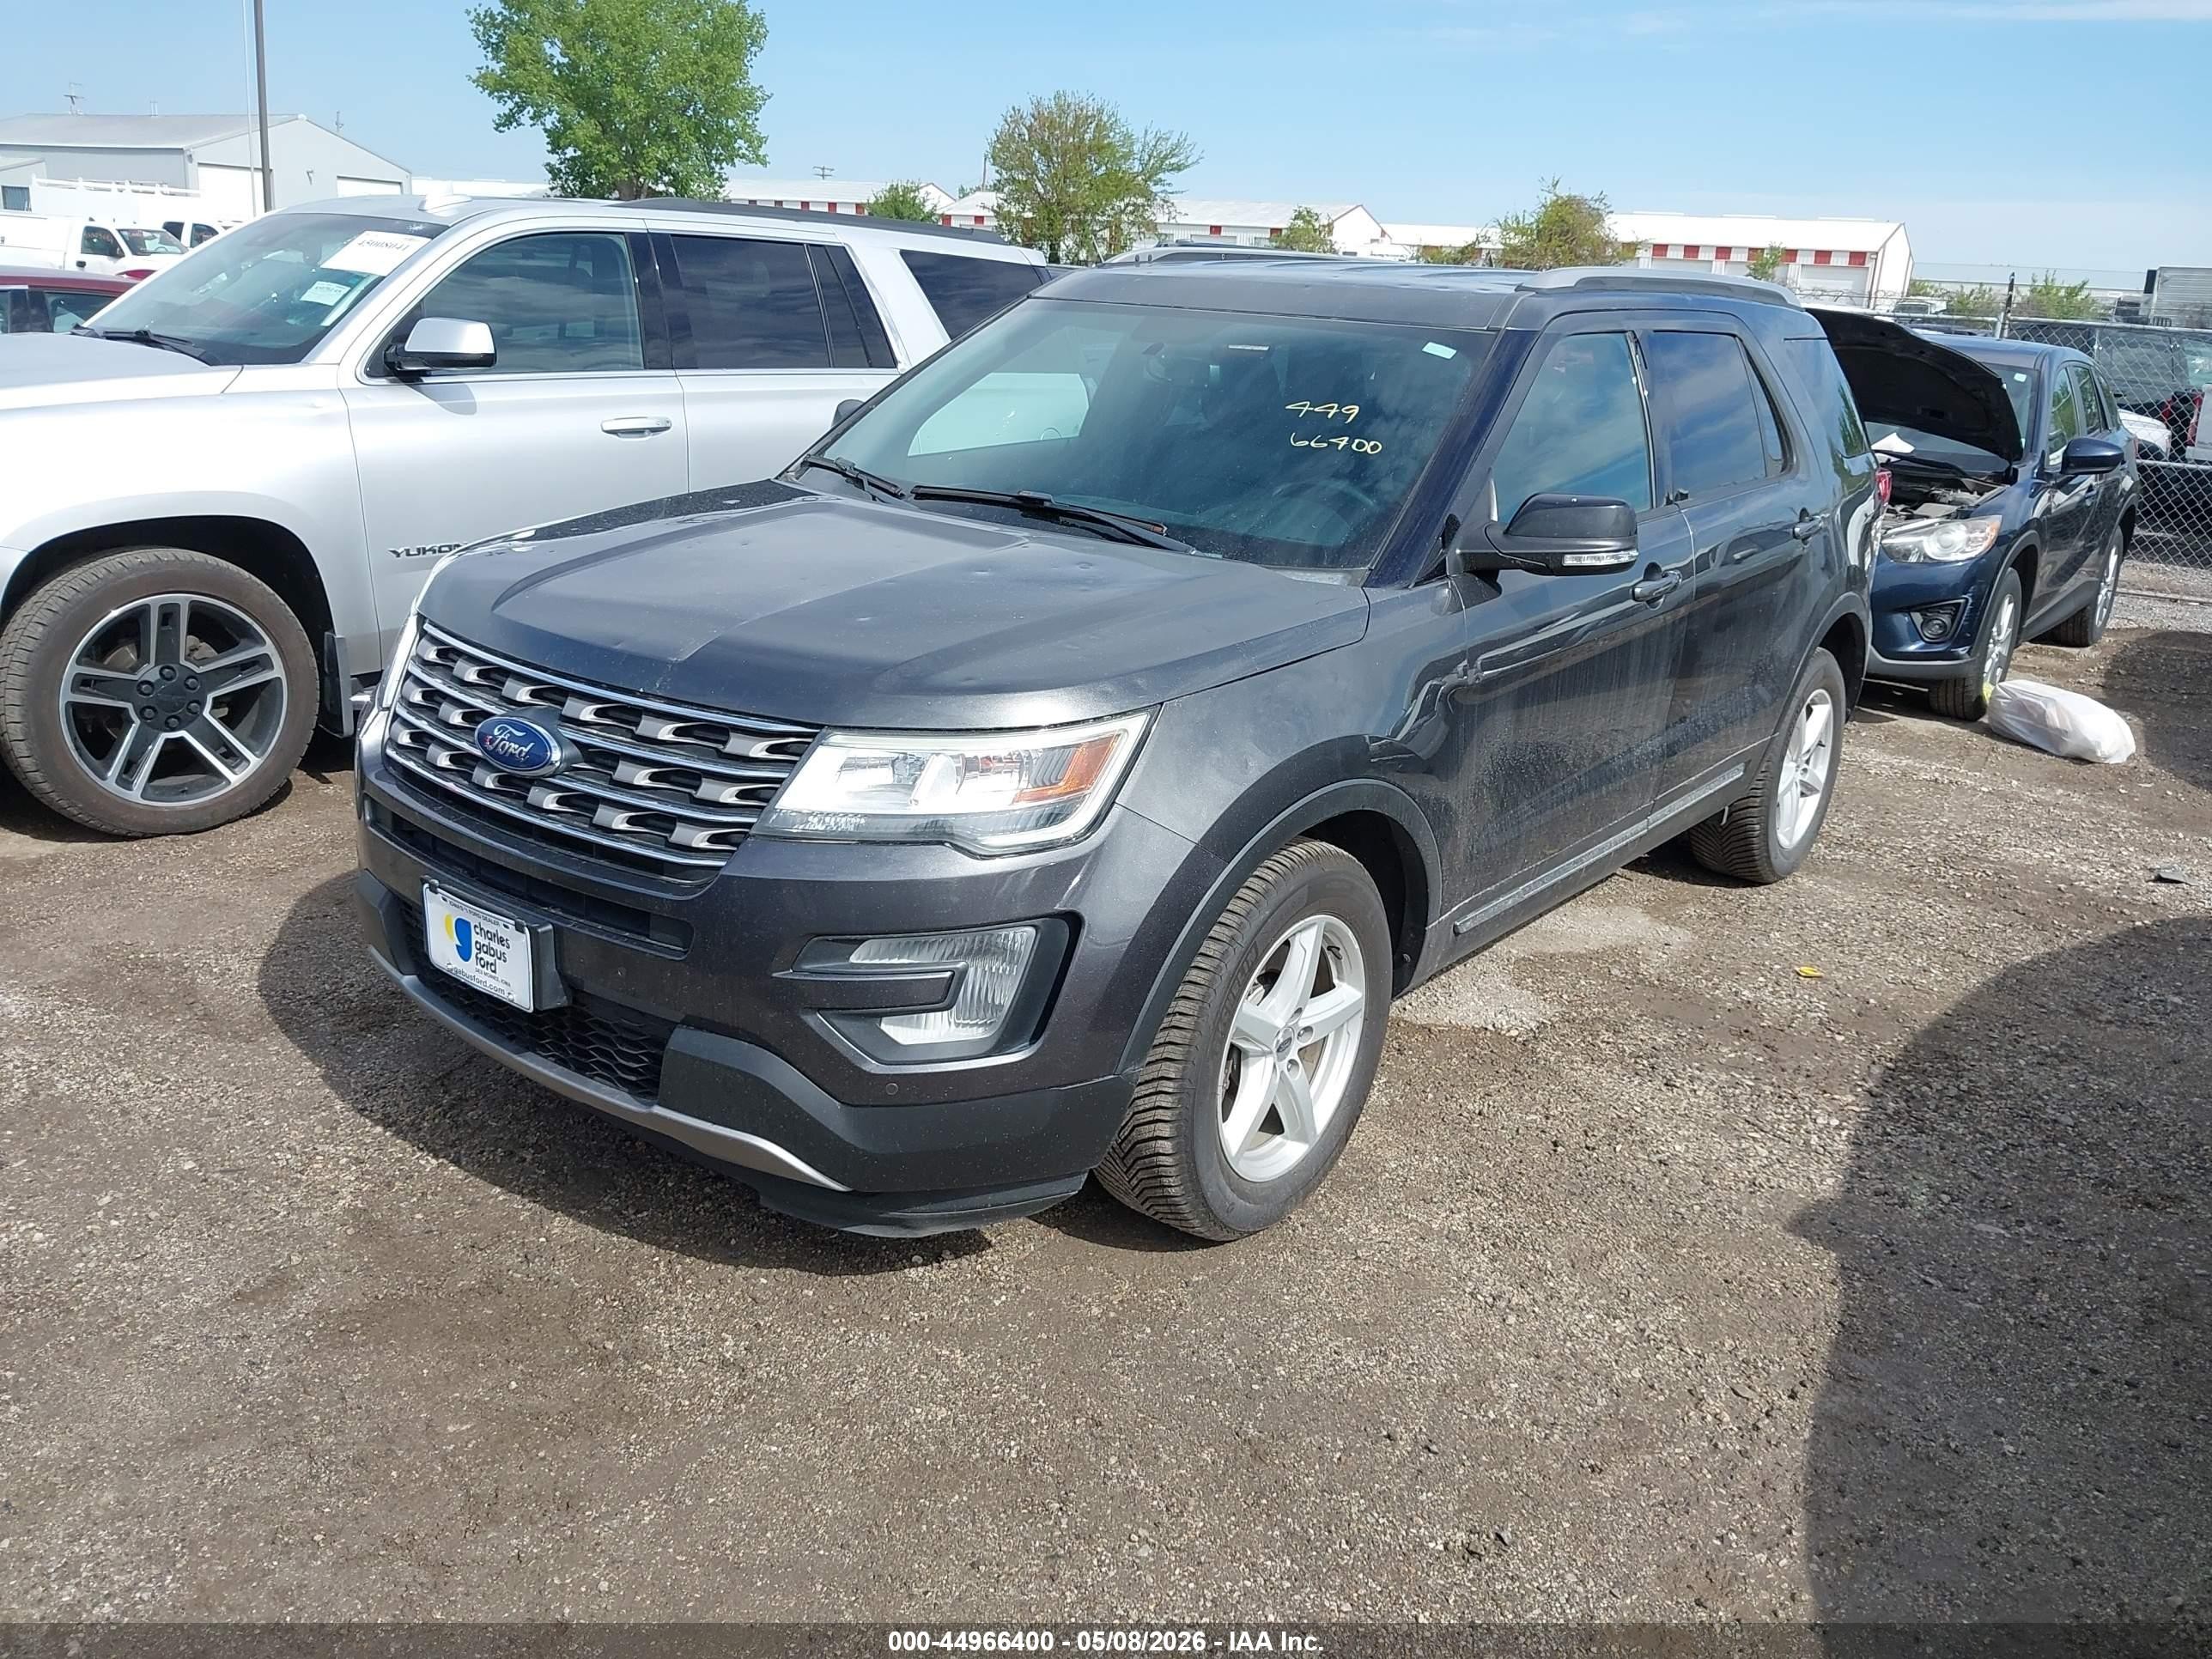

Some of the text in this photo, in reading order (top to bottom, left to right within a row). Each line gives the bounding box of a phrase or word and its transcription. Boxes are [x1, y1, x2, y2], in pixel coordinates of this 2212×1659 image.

[1285, 400, 1360, 424] 449
[1290, 432, 1382, 454] 66400
[483, 724, 536, 763] Ford
[473, 922, 511, 950] charles
[474, 939, 507, 963] gabus
[475, 952, 497, 975] ford
[453, 967, 506, 995] gabusford.com
